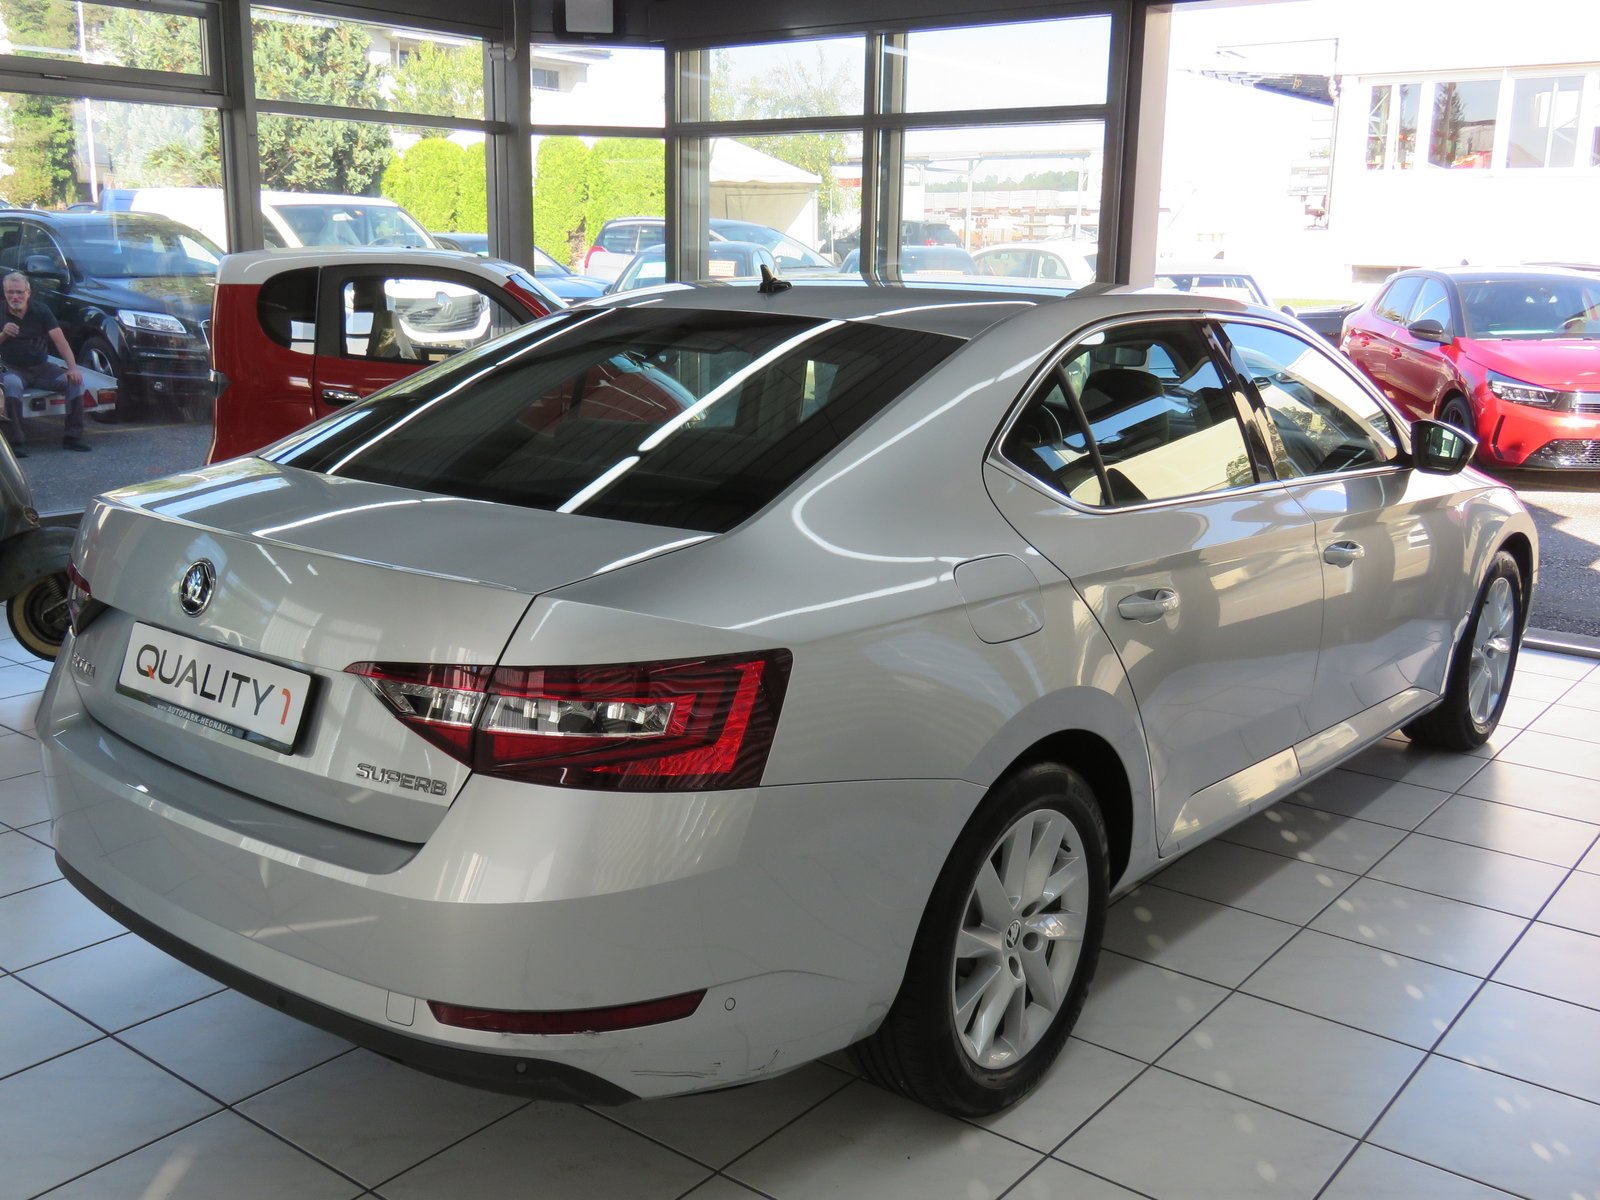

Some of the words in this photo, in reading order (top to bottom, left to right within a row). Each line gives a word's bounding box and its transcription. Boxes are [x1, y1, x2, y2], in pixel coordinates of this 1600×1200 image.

[136, 643, 275, 716] QUALITY
[281, 688, 292, 725] 1
[356, 763, 447, 796] SUPERB
